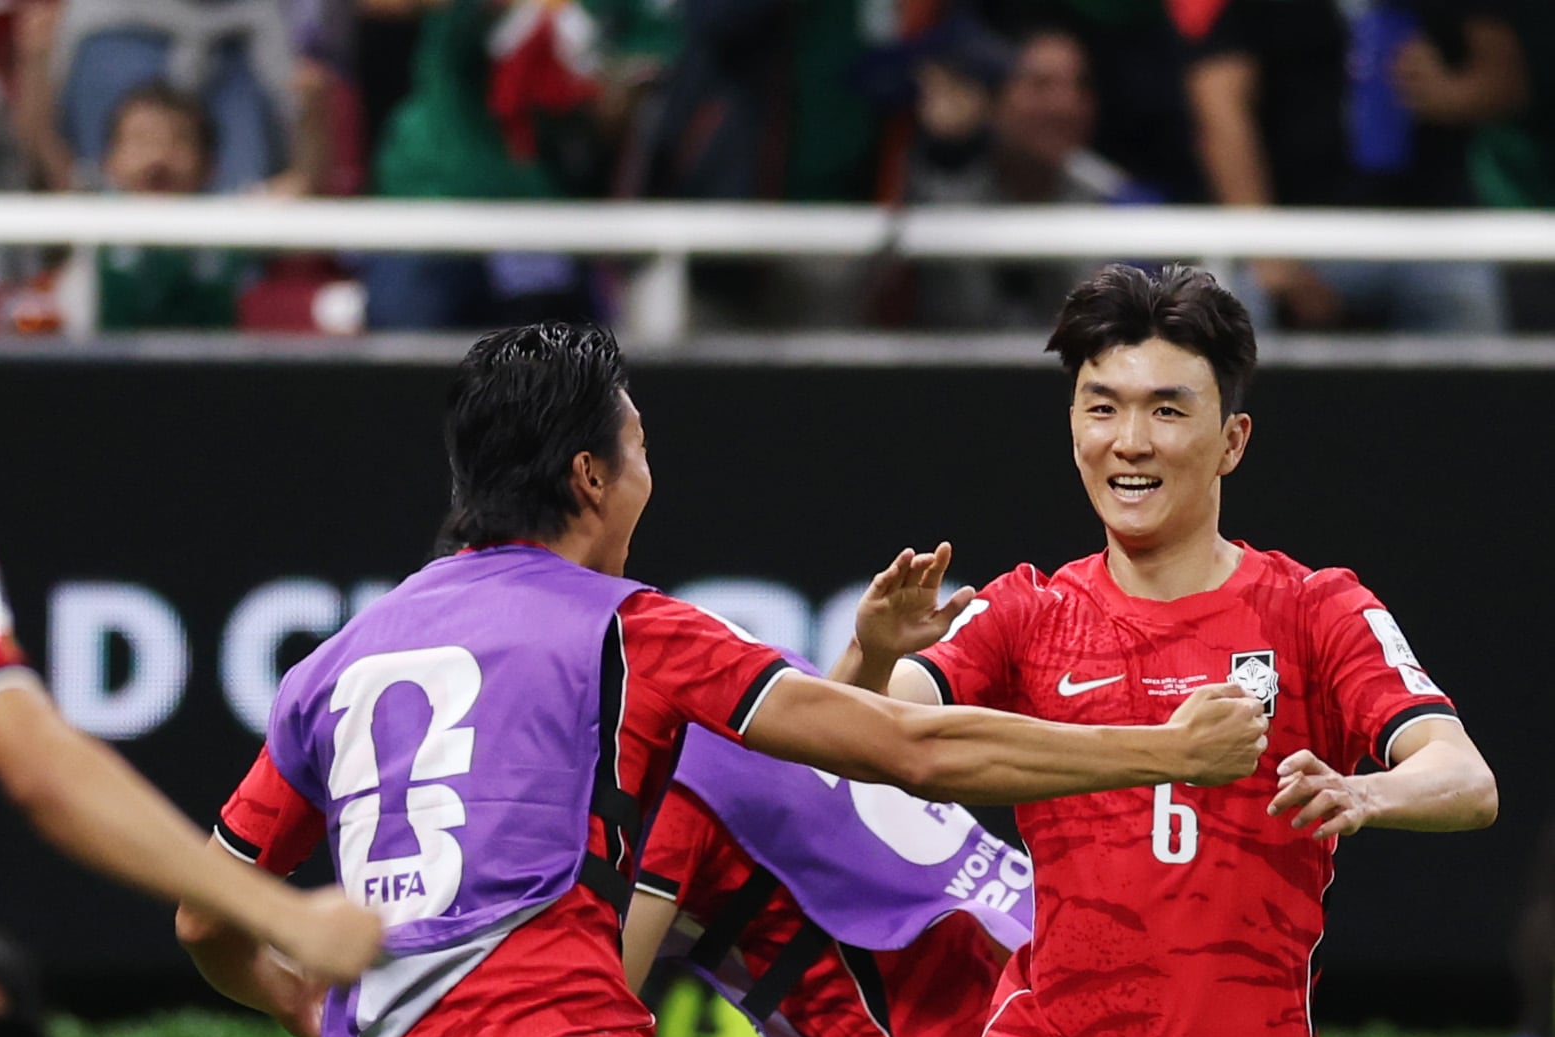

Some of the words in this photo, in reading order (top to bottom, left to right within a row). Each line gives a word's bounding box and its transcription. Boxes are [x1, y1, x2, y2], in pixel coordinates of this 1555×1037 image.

[1151, 782, 1200, 865] 6
[364, 870, 427, 908] FIFA
[944, 831, 1006, 900] WORL
[974, 848, 1035, 914] 20
